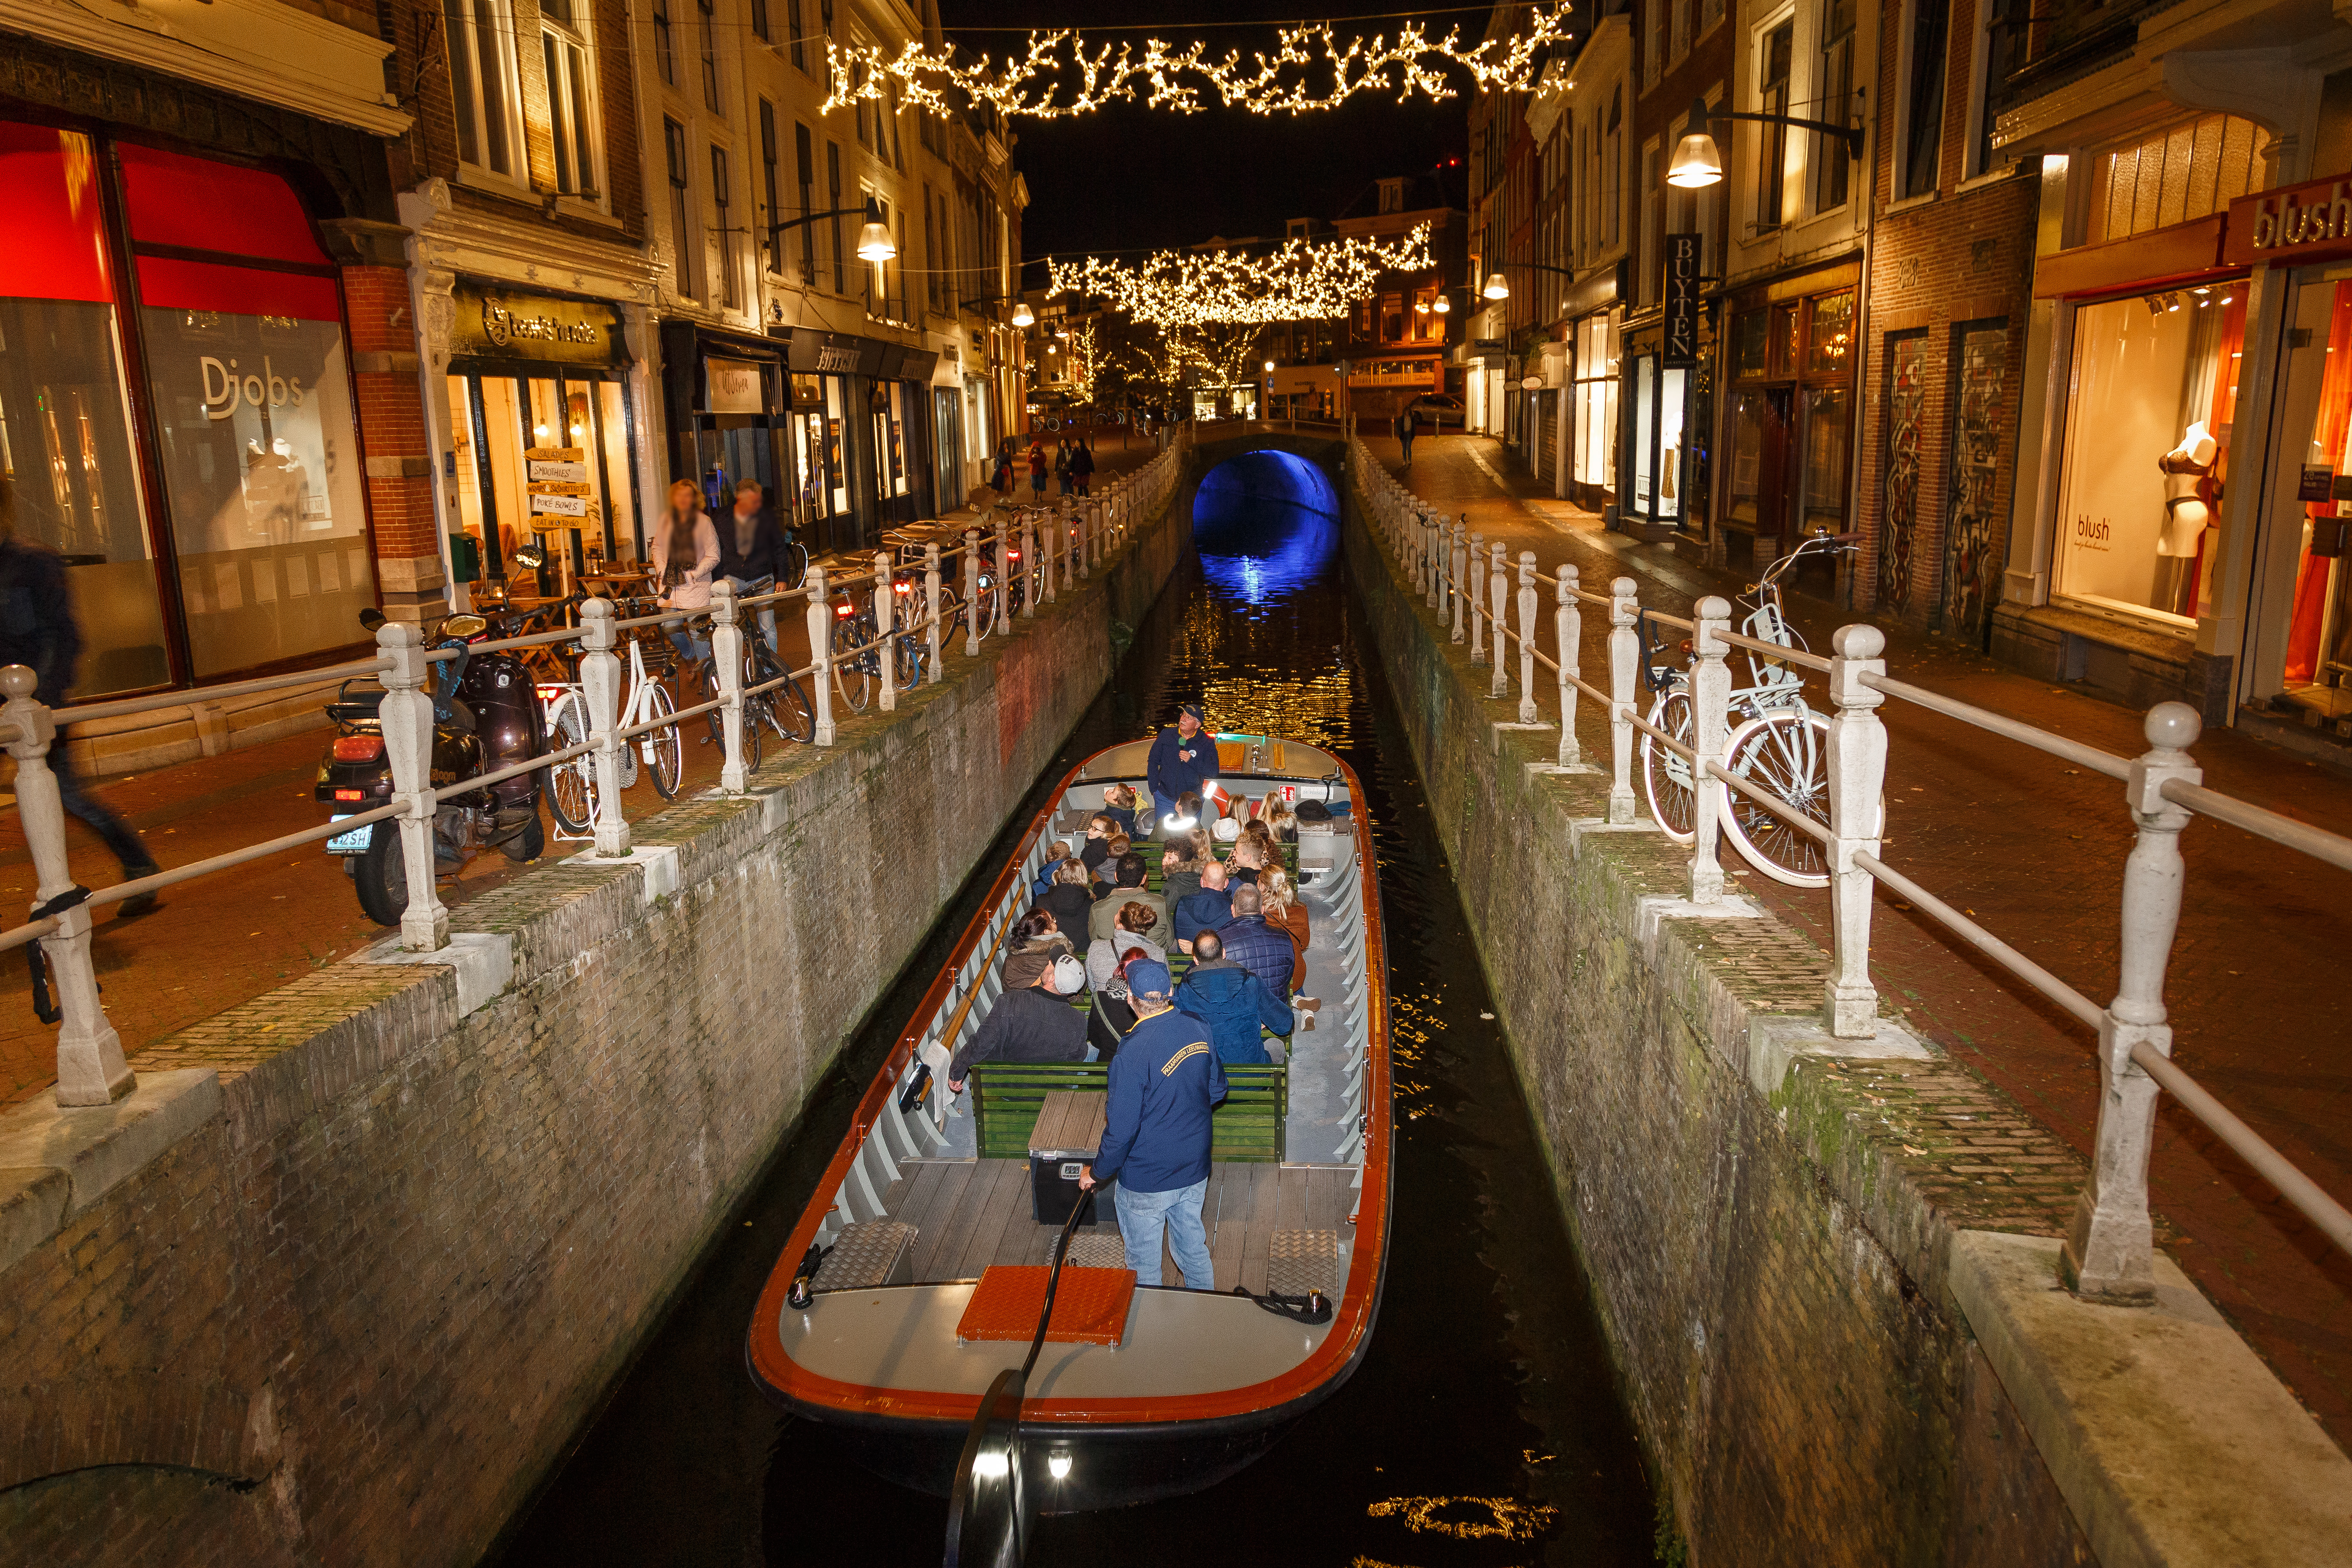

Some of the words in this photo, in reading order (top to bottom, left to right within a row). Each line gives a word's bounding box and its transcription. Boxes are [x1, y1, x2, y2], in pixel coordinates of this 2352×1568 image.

[2253, 181, 2352, 249] blush
[1671, 239, 1693, 356] BUYTEN
[200, 356, 304, 419] Djobs
[537, 449, 569, 459] SALADES
[534, 465, 570, 478] SMOOTHIES
[537, 498, 553, 507] POKÉ
[555, 500, 578, 511] BOWLS
[2078, 514, 2109, 541] blush
[1163, 1050, 1187, 1075] PRAAMVAREN
